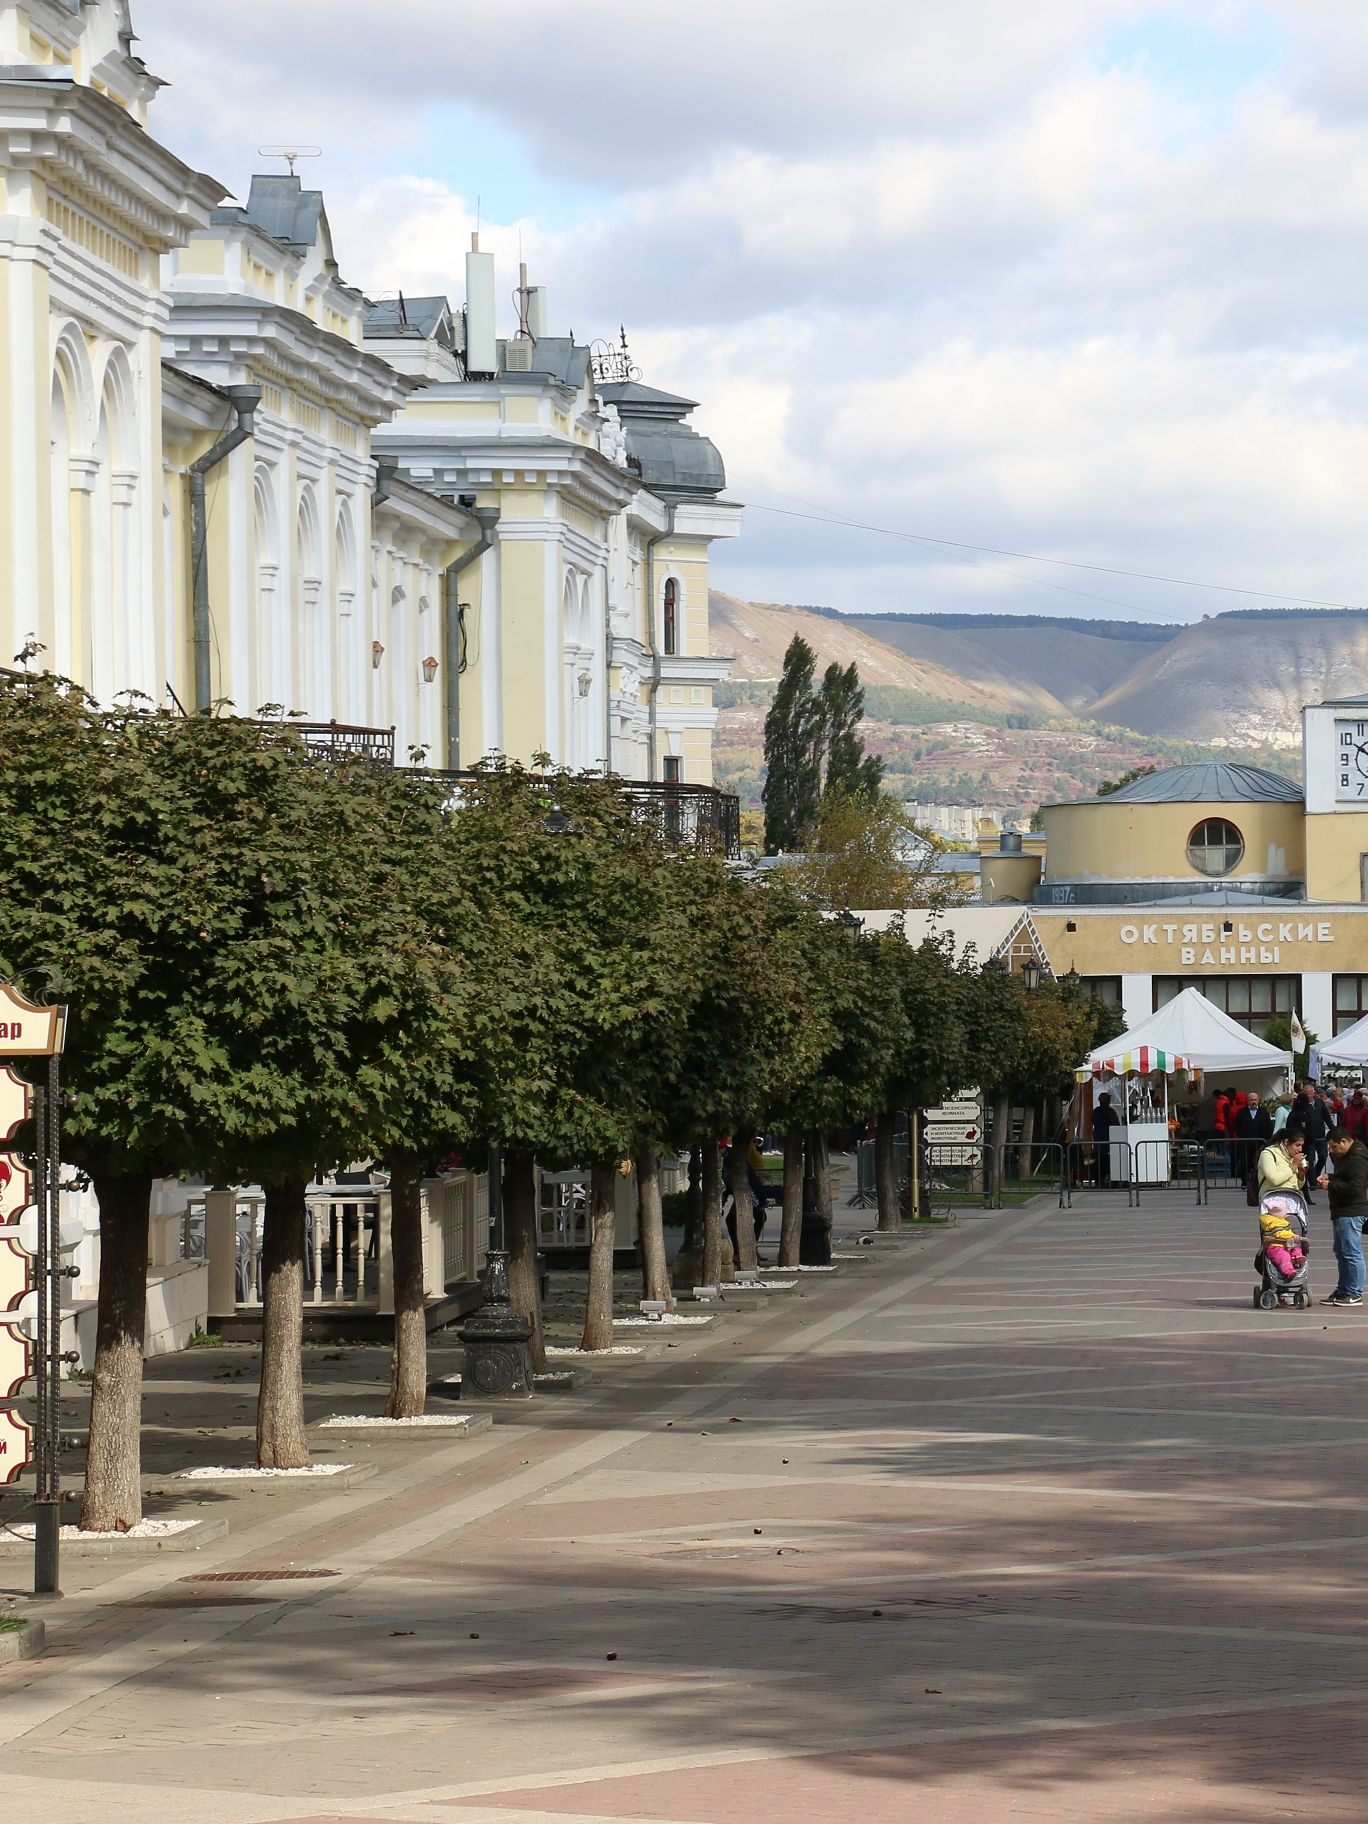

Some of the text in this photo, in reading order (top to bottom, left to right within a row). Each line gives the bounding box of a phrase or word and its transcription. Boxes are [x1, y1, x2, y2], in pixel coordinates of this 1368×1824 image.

[1357, 723, 1364, 737] 11
[1340, 732, 1353, 746] 10
[1341, 753, 1349, 766] 9
[1341, 774, 1349, 787] 8
[1356, 783, 1365, 796] 7
[1180, 946, 1281, 965] ВАННЫ
